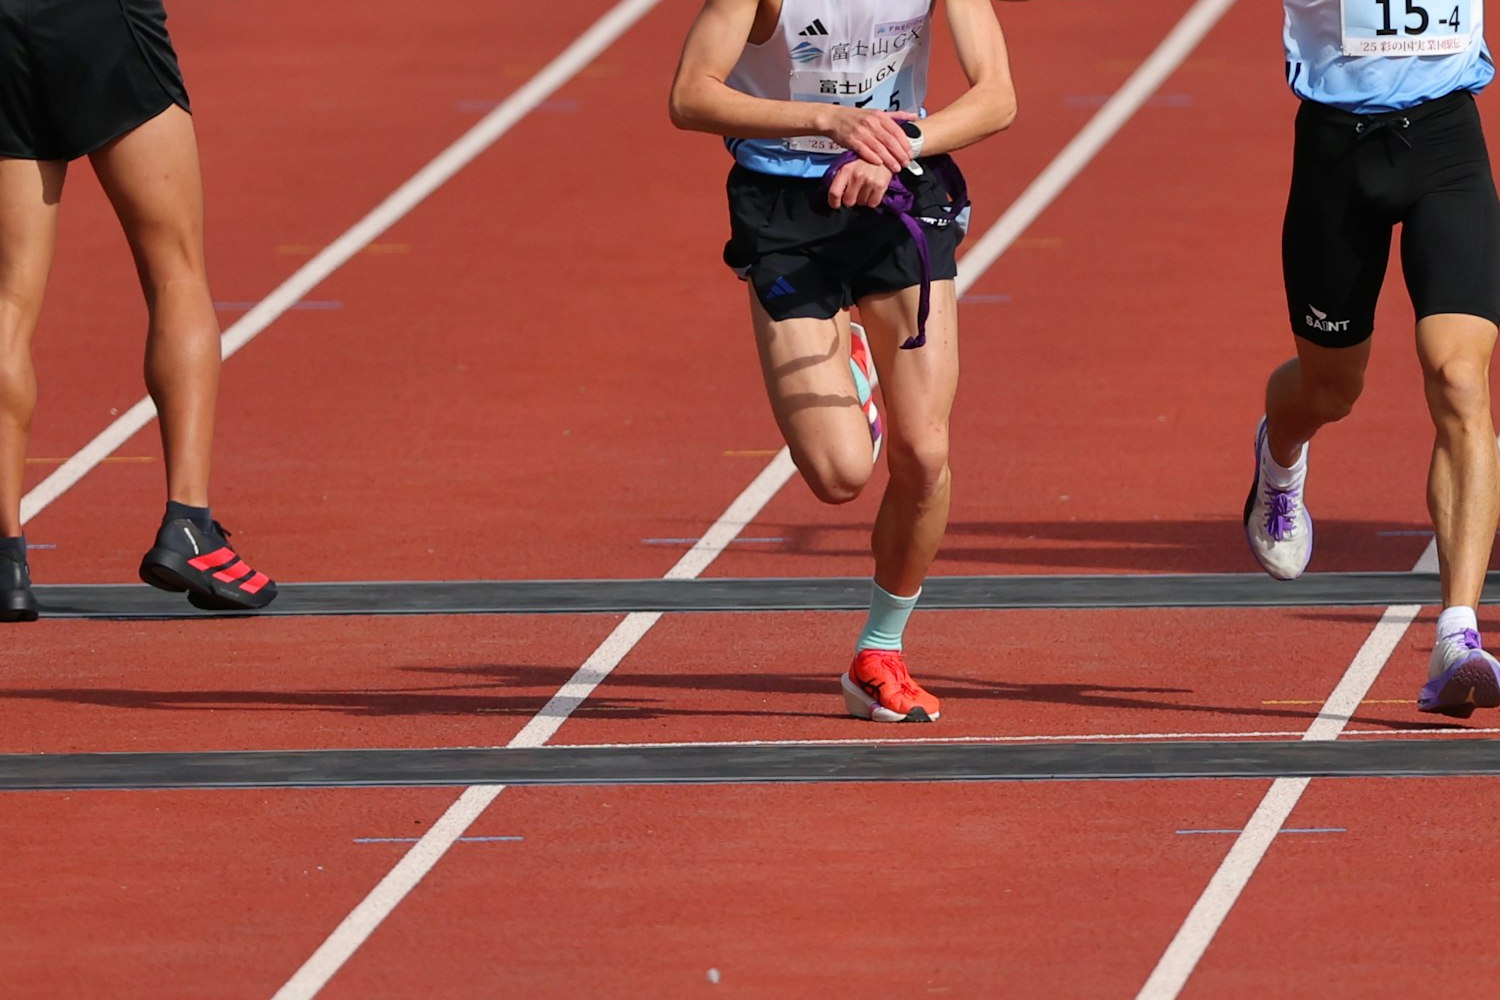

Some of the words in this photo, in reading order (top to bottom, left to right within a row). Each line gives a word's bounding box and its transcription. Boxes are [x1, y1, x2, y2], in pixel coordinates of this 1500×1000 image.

[819, 77, 873, 95] 富士山
[876, 61, 897, 82] GX
